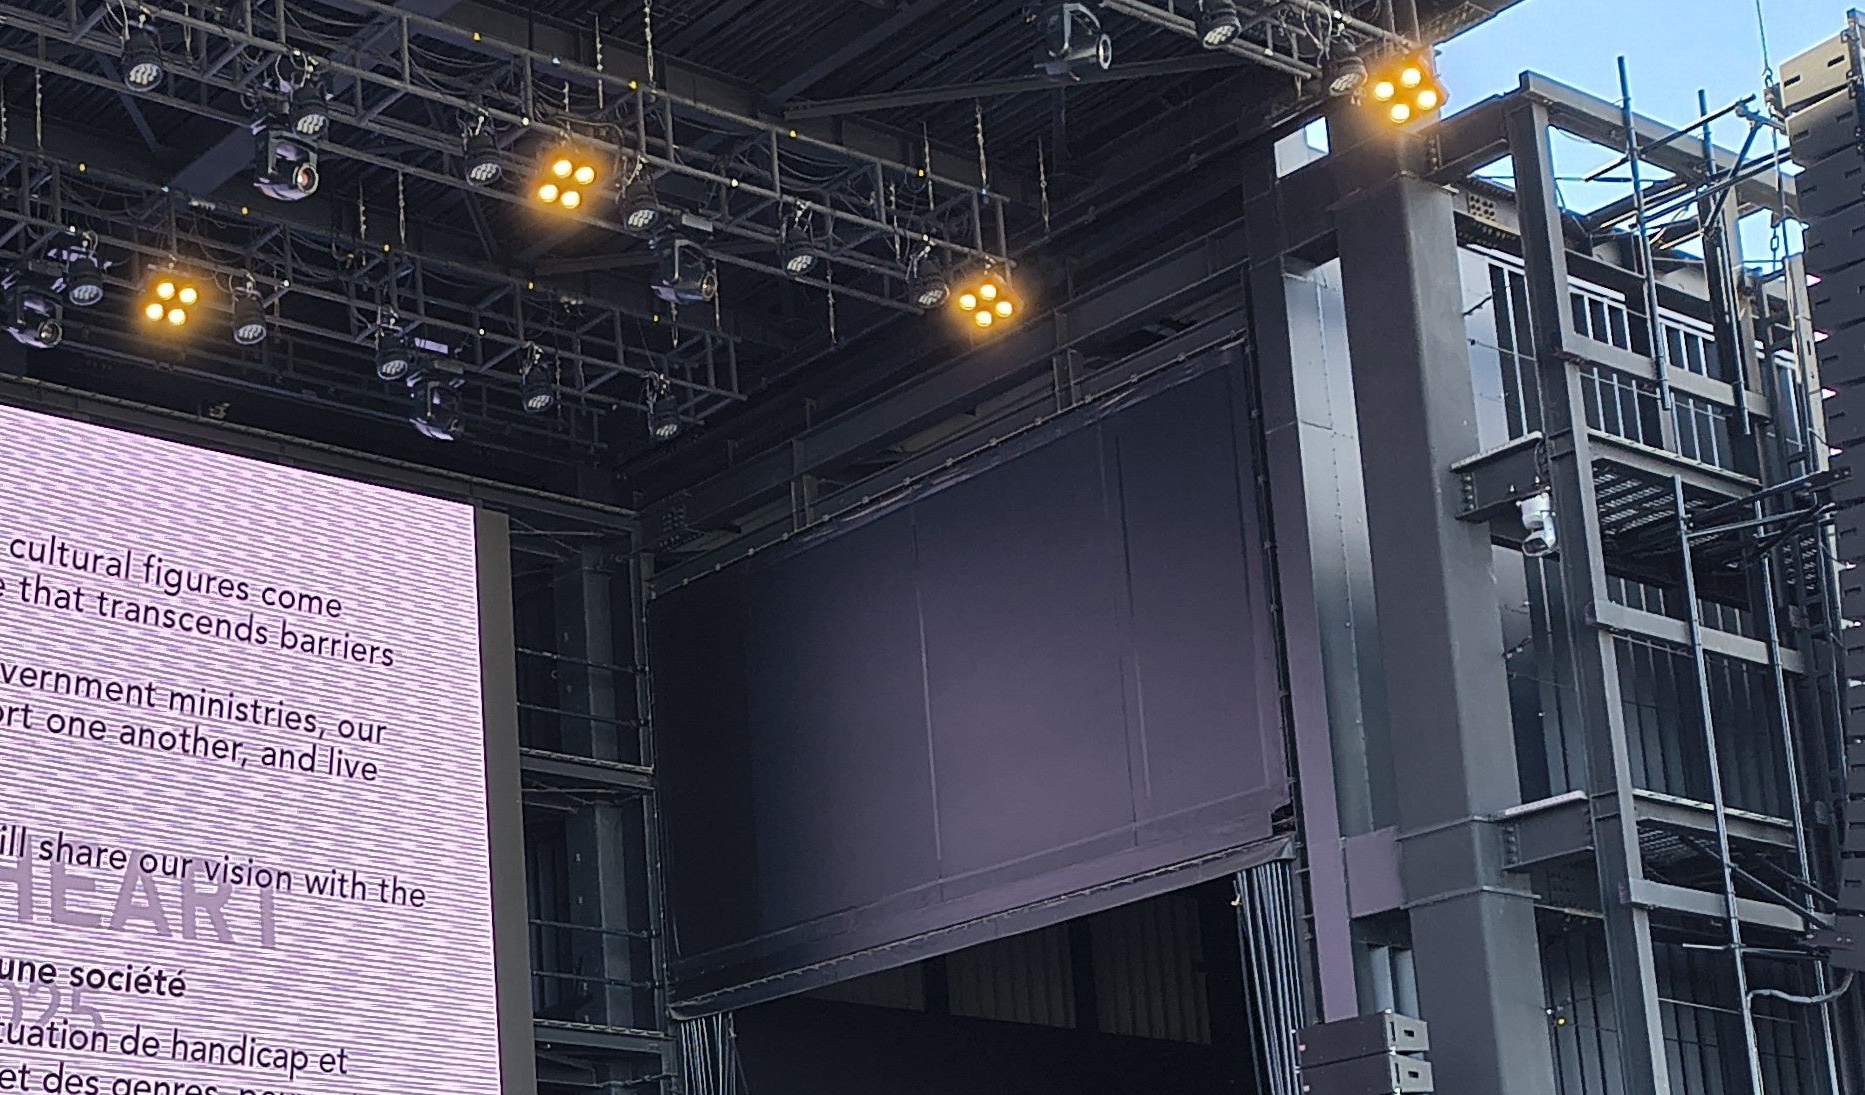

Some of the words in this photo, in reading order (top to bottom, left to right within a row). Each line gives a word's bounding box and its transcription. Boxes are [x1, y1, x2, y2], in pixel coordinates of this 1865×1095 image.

[8, 533, 133, 581] cultural
[141, 552, 250, 602] figures
[260, 585, 343, 619] come
[17, 572, 86, 614] that
[95, 589, 269, 646] transcends
[279, 618, 395, 668] barriers
[45, 712, 108, 742] one
[118, 723, 249, 769] another,
[260, 741, 318, 774] and
[327, 745, 379, 783] live
[167, 686, 326, 741] ministries,
[336, 718, 388, 745] our
[37, 829, 129, 871] share
[138, 852, 195, 880] our
[202, 853, 293, 892] vision
[303, 868, 368, 902] with
[377, 874, 427, 909] the
[68, 962, 187, 999] société
[119, 1023, 161, 1059] de
[170, 1027, 310, 1082] handicap
[318, 1046, 349, 1076] et
